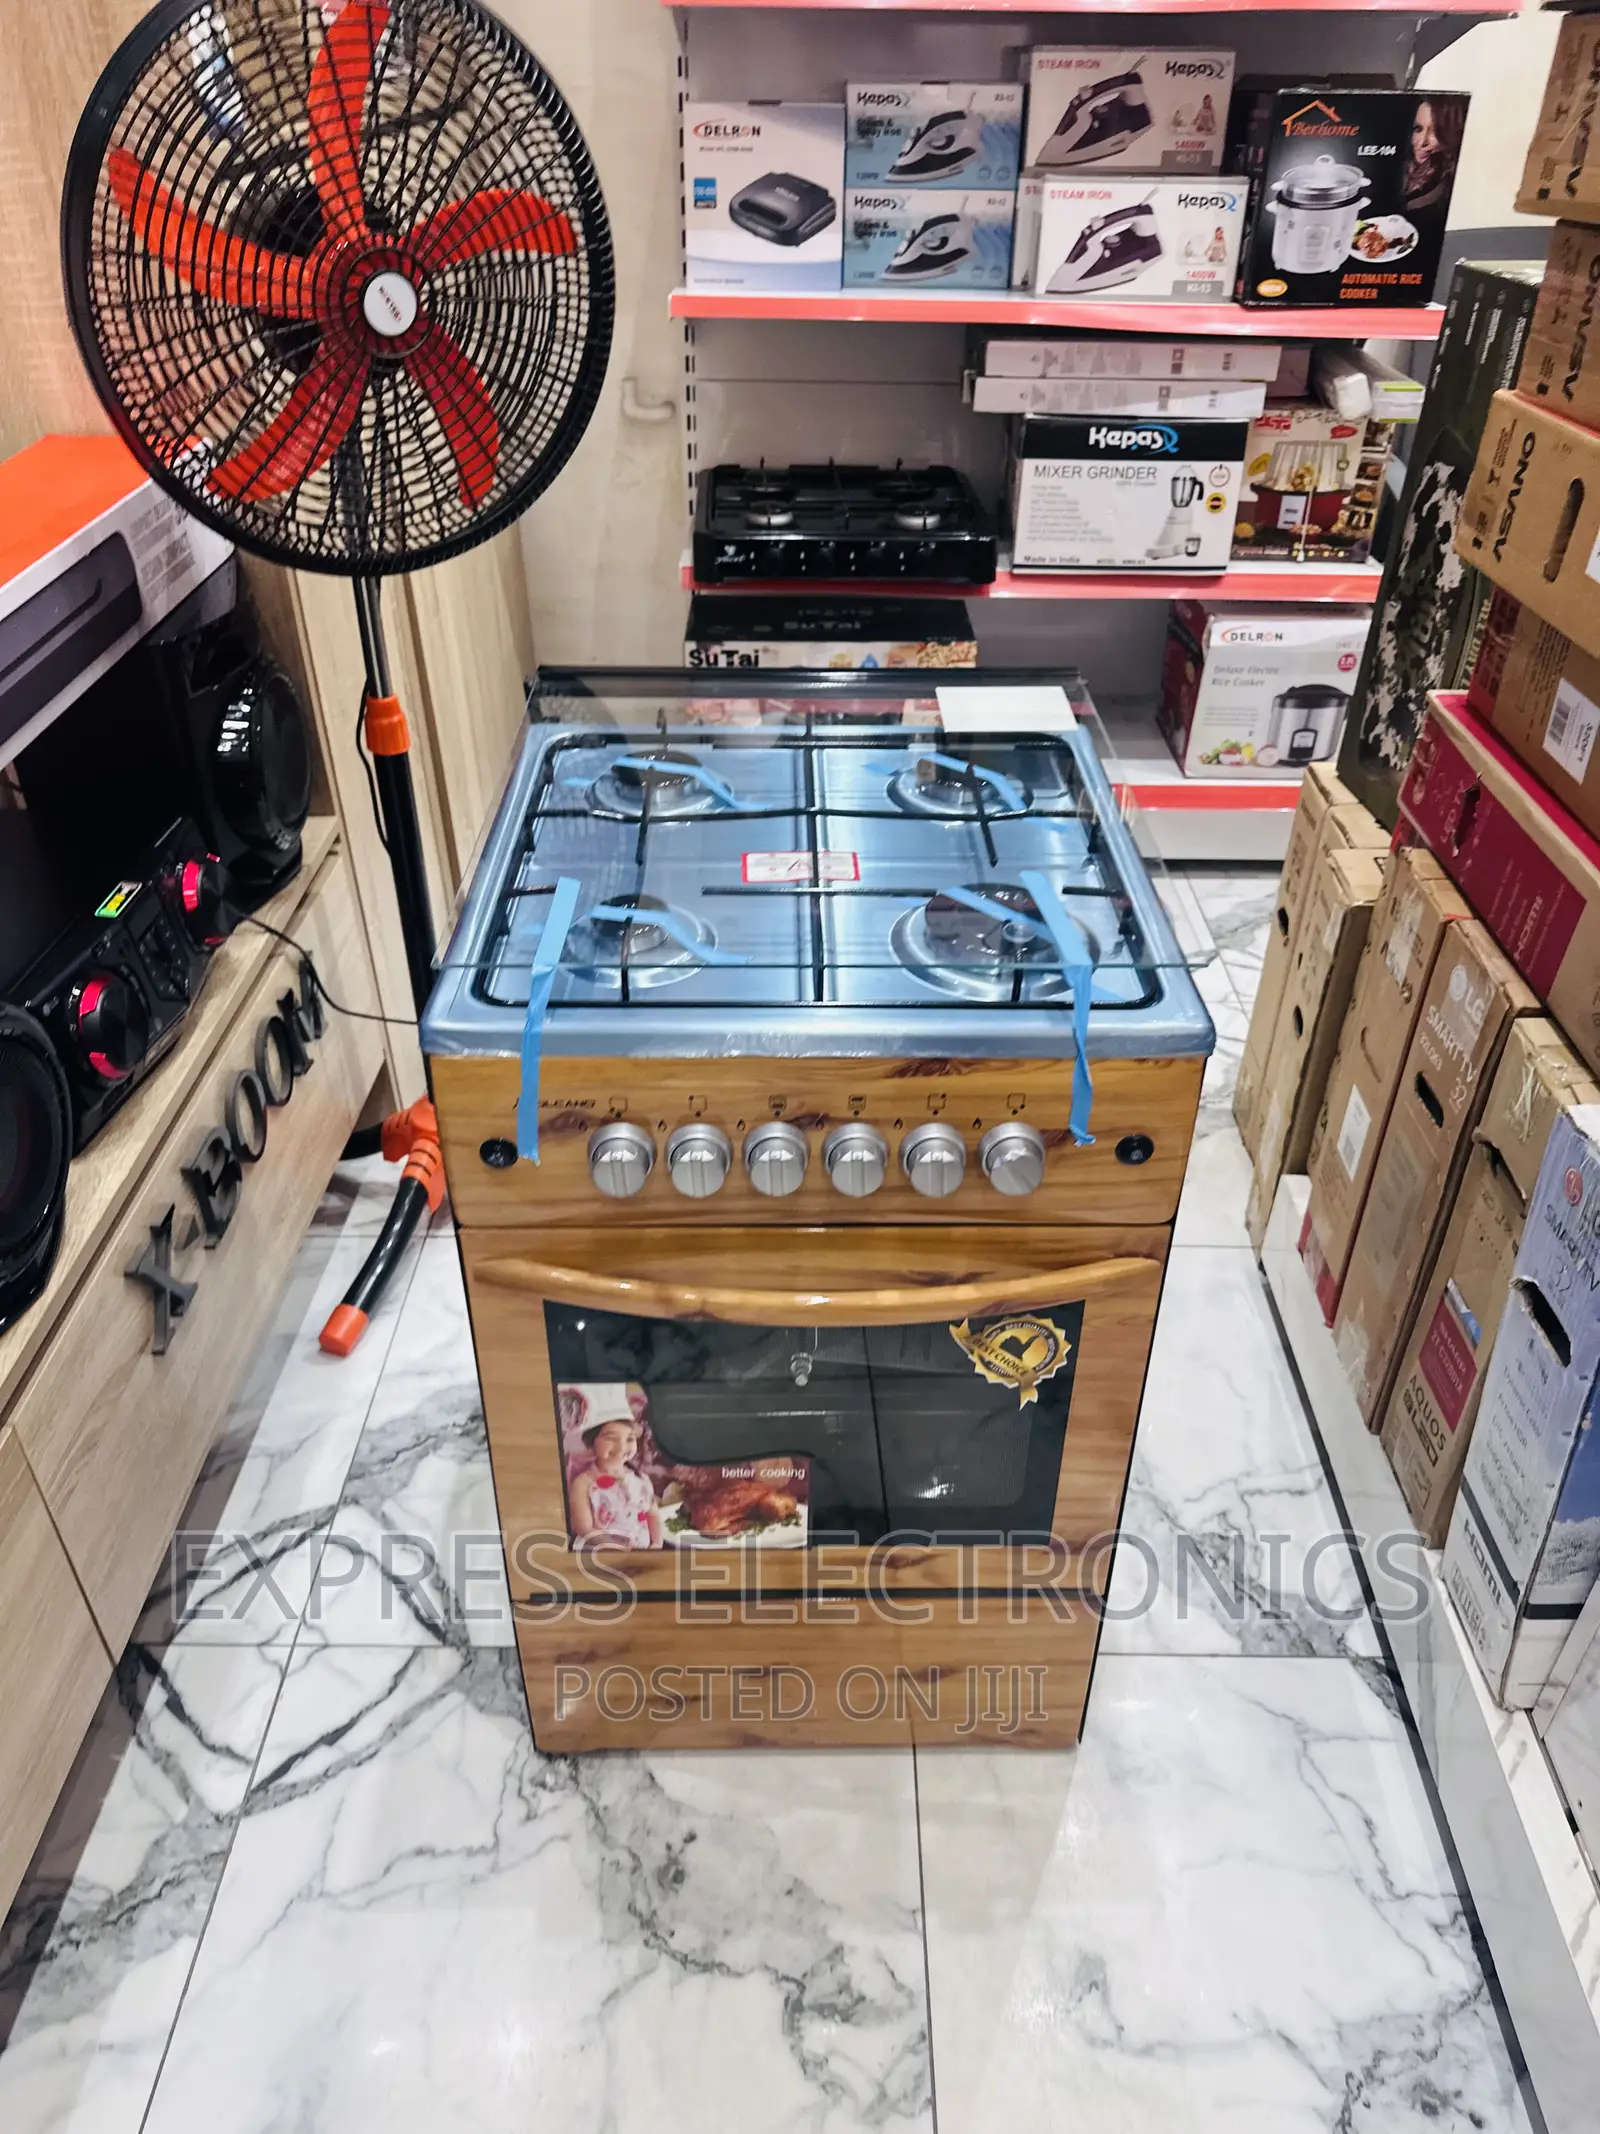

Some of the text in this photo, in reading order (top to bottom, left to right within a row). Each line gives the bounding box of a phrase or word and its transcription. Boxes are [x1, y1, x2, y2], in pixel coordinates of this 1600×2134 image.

[1037, 60, 1101, 70] STEAM IRON
[703, 124, 761, 138] DELRON
[1292, 121, 1360, 138] Berhome
[1050, 190, 1085, 200] STEAM
[1087, 190, 1113, 200] IRON
[1177, 193, 1227, 210] Kepas
[1341, 273, 1424, 286] AUTOMATIC RICE
[1339, 288, 1378, 299] COOKER
[1089, 426, 1165, 450] Kepas
[1033, 464, 1158, 481] MIXER GRINDER
[1493, 431, 1536, 563] ASANO
[1024, 555, 1047, 564] Made
[1058, 555, 1081, 565] India
[1230, 632, 1284, 642] DELRON
[689, 648, 760, 667] SuTai
[1213, 665, 1280, 675] Deluxe Electric
[1212, 677, 1265, 687] Rice Cooker
[1513, 895, 1544, 962] HDMI
[1465, 986, 1486, 1025] LG
[1426, 1005, 1464, 1062] SMART
[1460, 1052, 1478, 1083] TV
[1449, 1076, 1471, 1111] 32
[123, 948, 328, 1356] X-BOOM
[971, 1338, 995, 1357] BEST
[994, 1351, 1029, 1376] CHOICE
[1409, 1374, 1447, 1451] AQUOS
[721, 1466, 806, 1481] better cooking
[1463, 1518, 1502, 1606] HDMI
